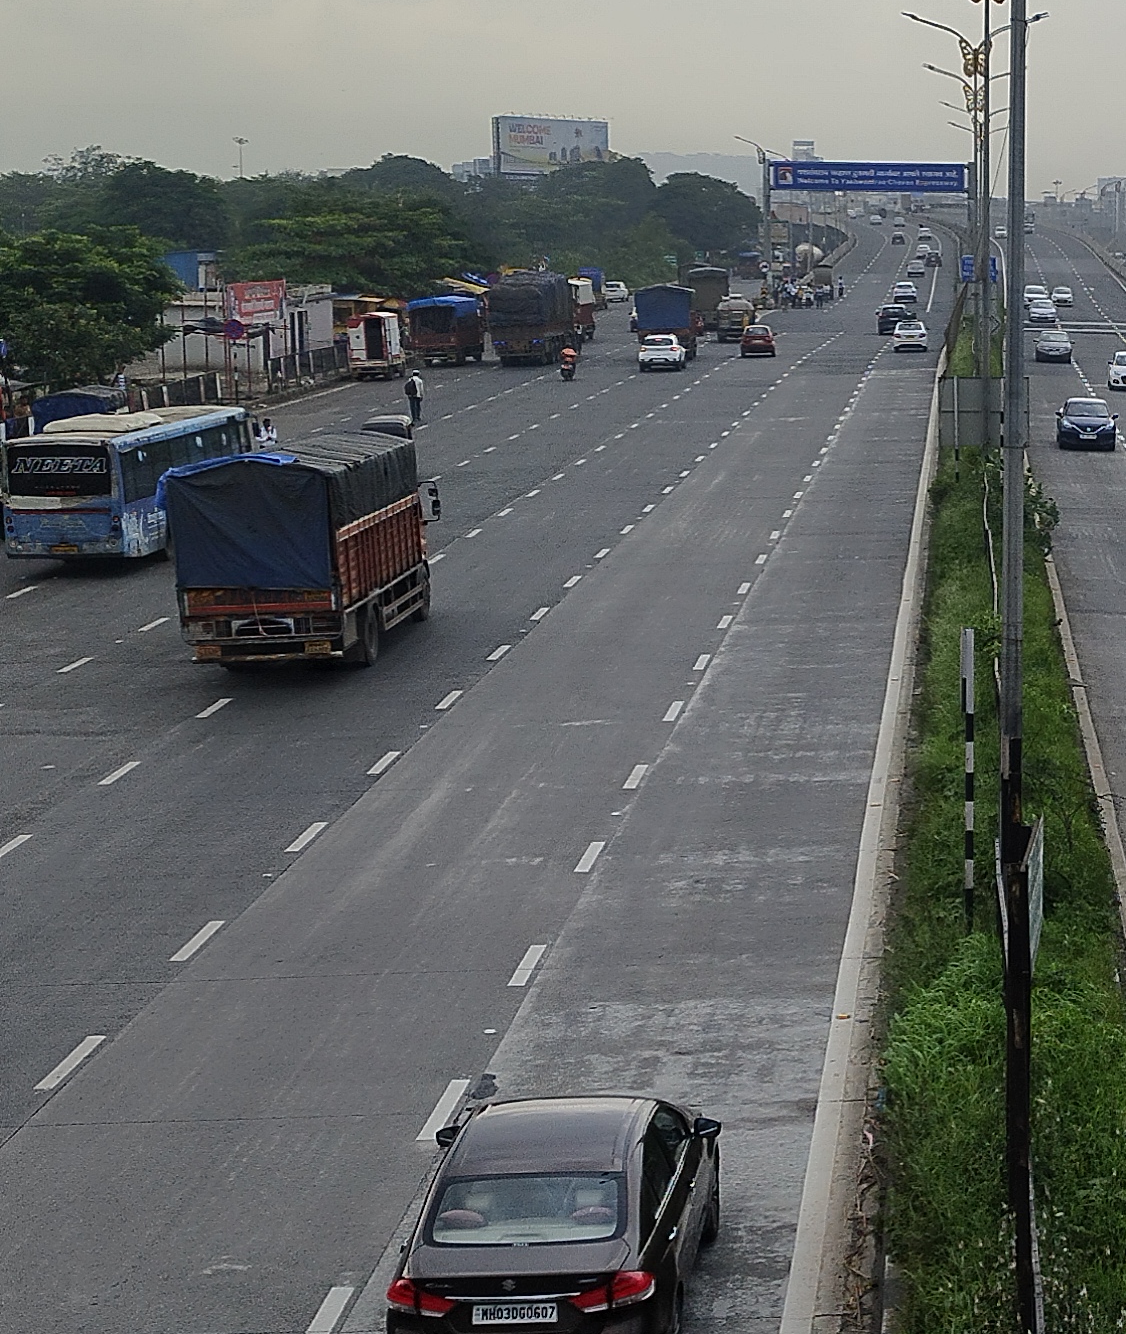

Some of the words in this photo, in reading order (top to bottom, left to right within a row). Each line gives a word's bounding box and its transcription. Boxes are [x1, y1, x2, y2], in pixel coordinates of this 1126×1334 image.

[508, 123, 551, 135] WELCOME
[508, 134, 544, 146] MUMBAI
[11, 457, 108, 474] NEETA
